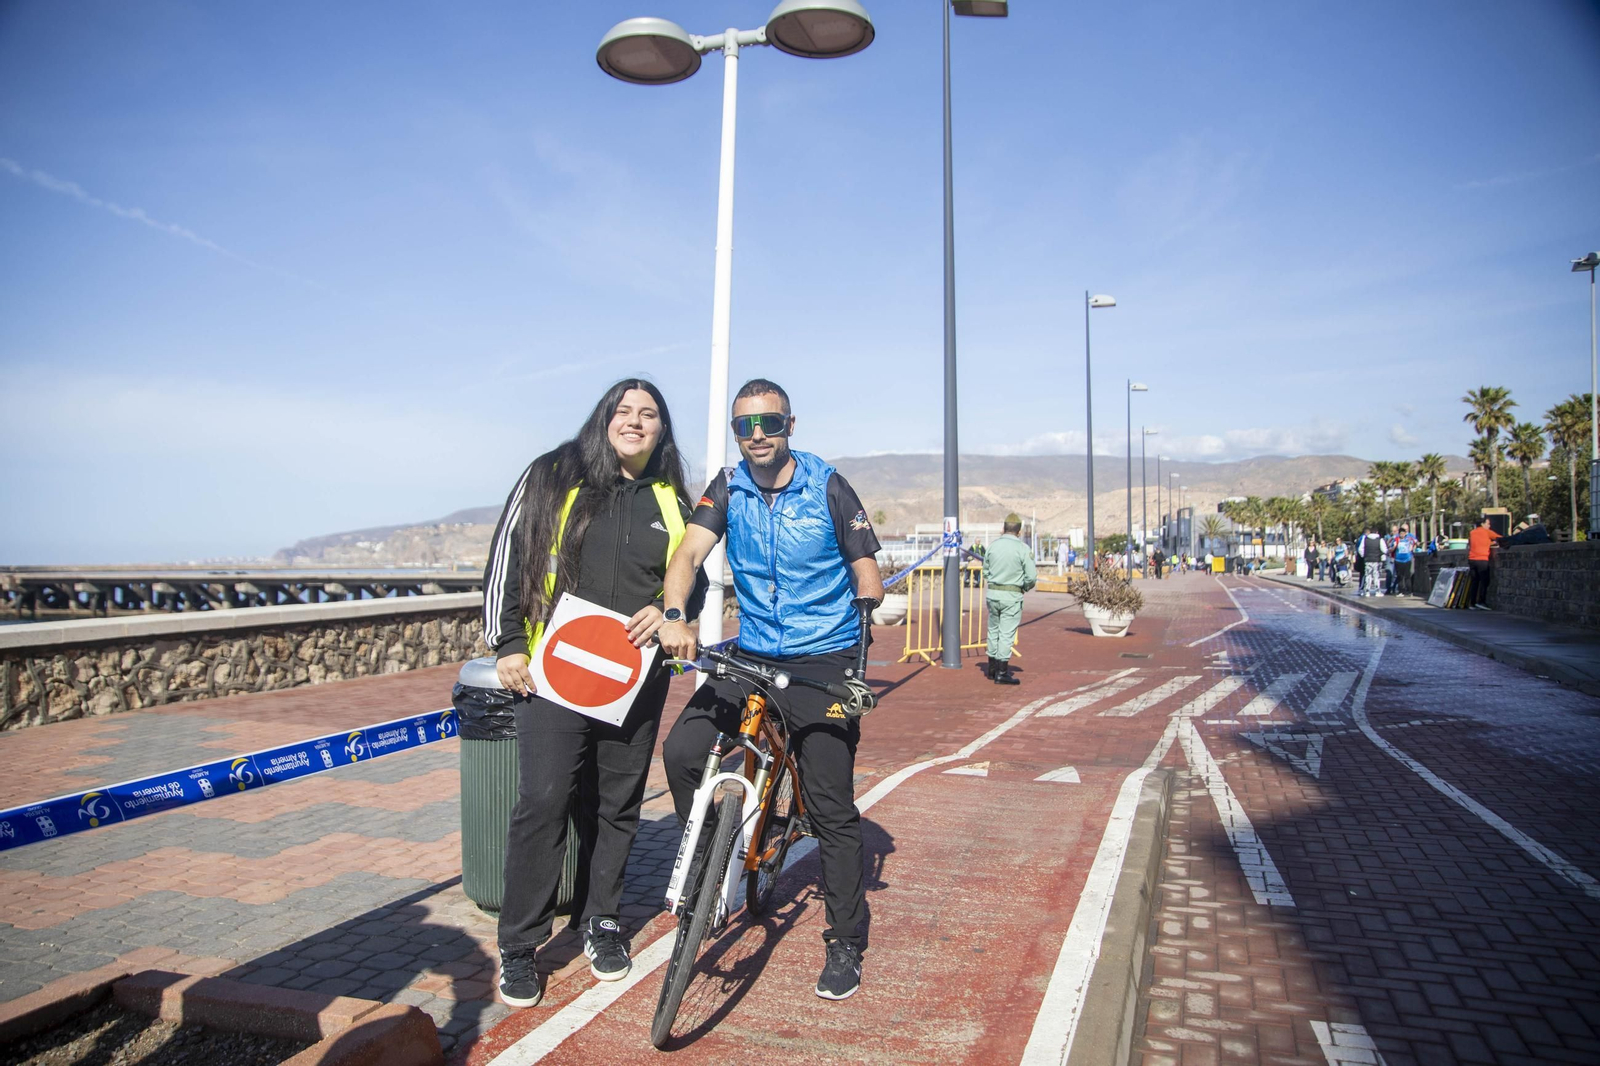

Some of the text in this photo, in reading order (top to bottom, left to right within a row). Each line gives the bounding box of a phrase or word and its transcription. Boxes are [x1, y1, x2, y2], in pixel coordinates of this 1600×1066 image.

[372, 734, 408, 749] Ayuntamiento
[298, 751, 307, 759] de
[265, 758, 309, 775] Ayuntamiento
[169, 782, 180, 790] de
[125, 789, 183, 808] Ayuntamiento
